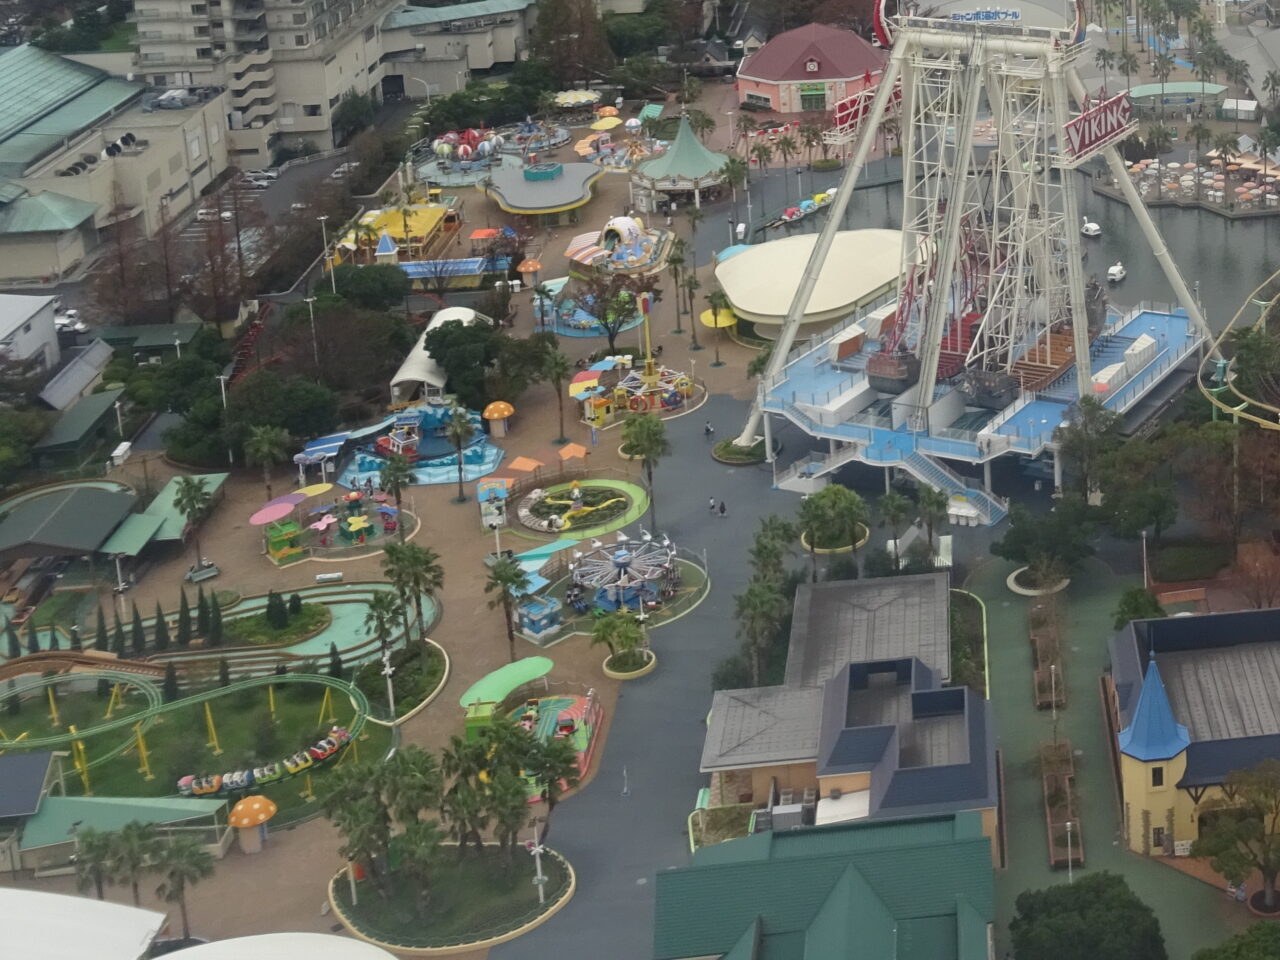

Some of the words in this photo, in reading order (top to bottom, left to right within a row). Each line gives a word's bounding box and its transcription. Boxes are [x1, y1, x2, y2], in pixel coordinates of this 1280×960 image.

[951, 10, 1020, 21] ジャンボ海水プール
[1067, 97, 1130, 154] VIKING
